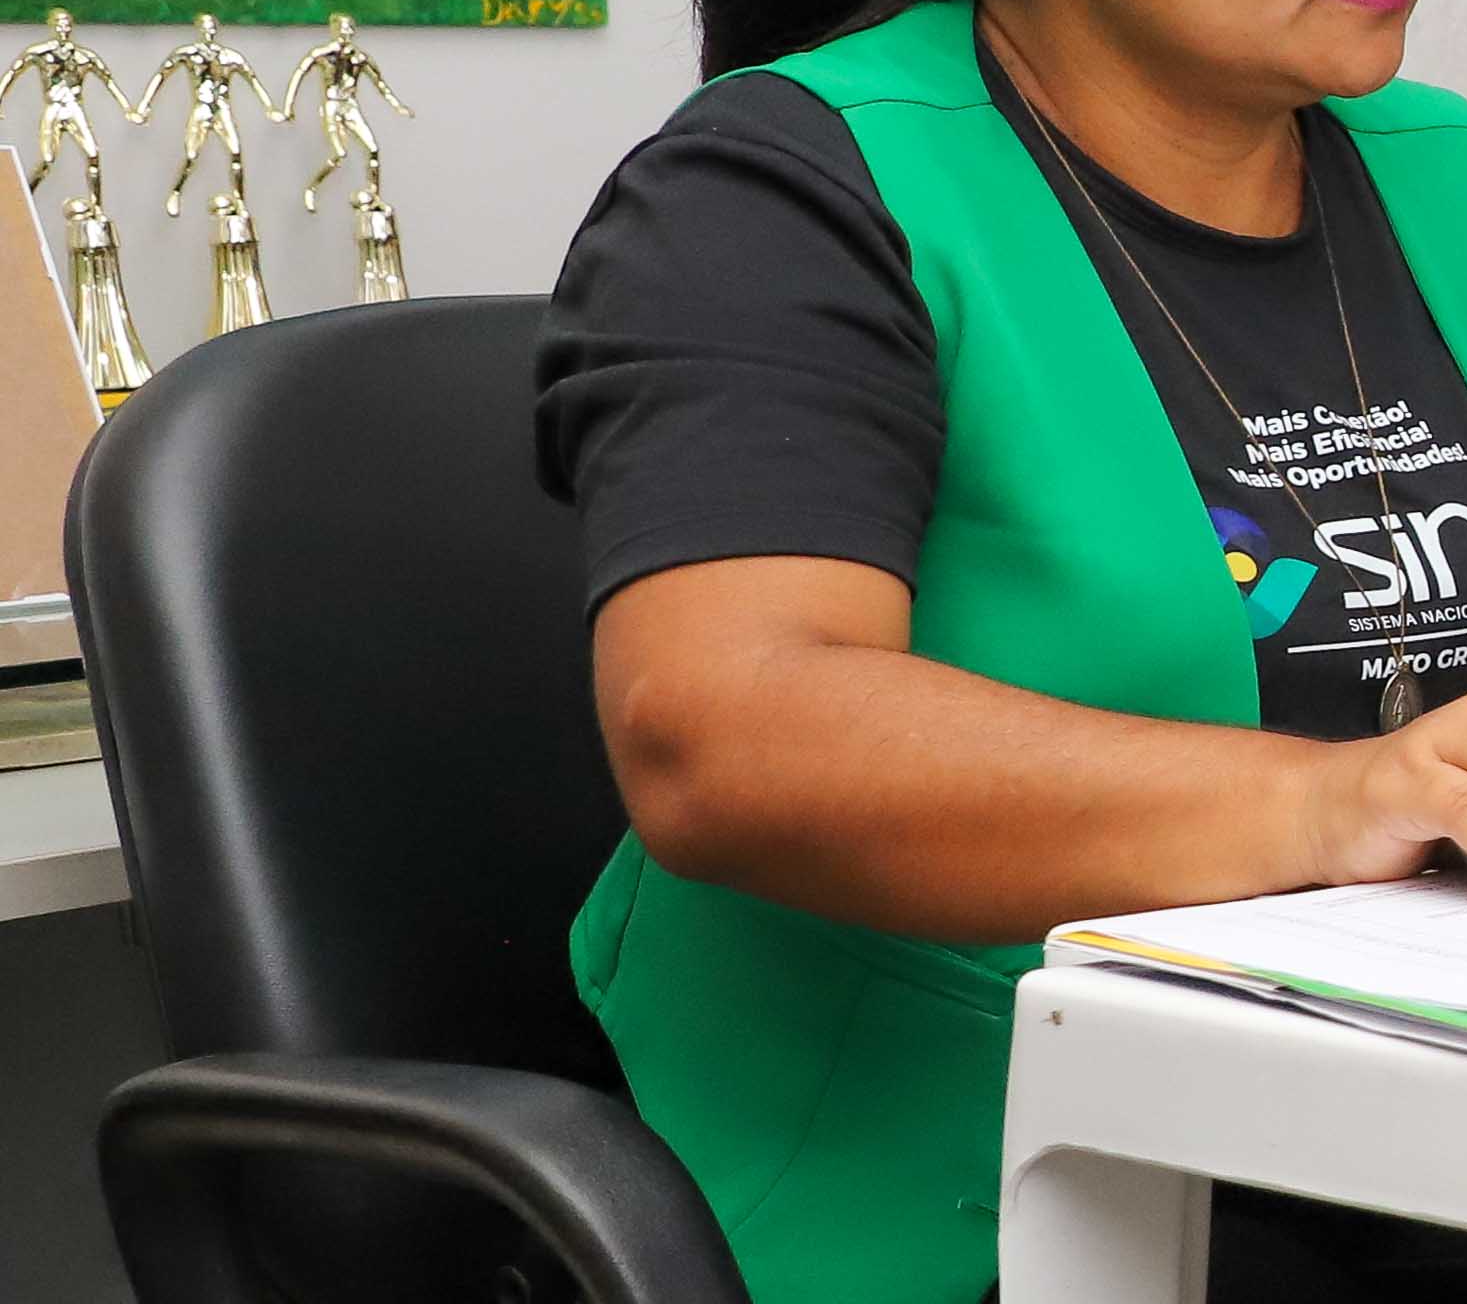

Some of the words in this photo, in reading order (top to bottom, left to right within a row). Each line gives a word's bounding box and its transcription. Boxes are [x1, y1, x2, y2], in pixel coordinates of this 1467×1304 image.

[1241, 409, 1310, 438] Mais
[1244, 438, 1309, 466] Mais
[1226, 466, 1285, 489] Mais
